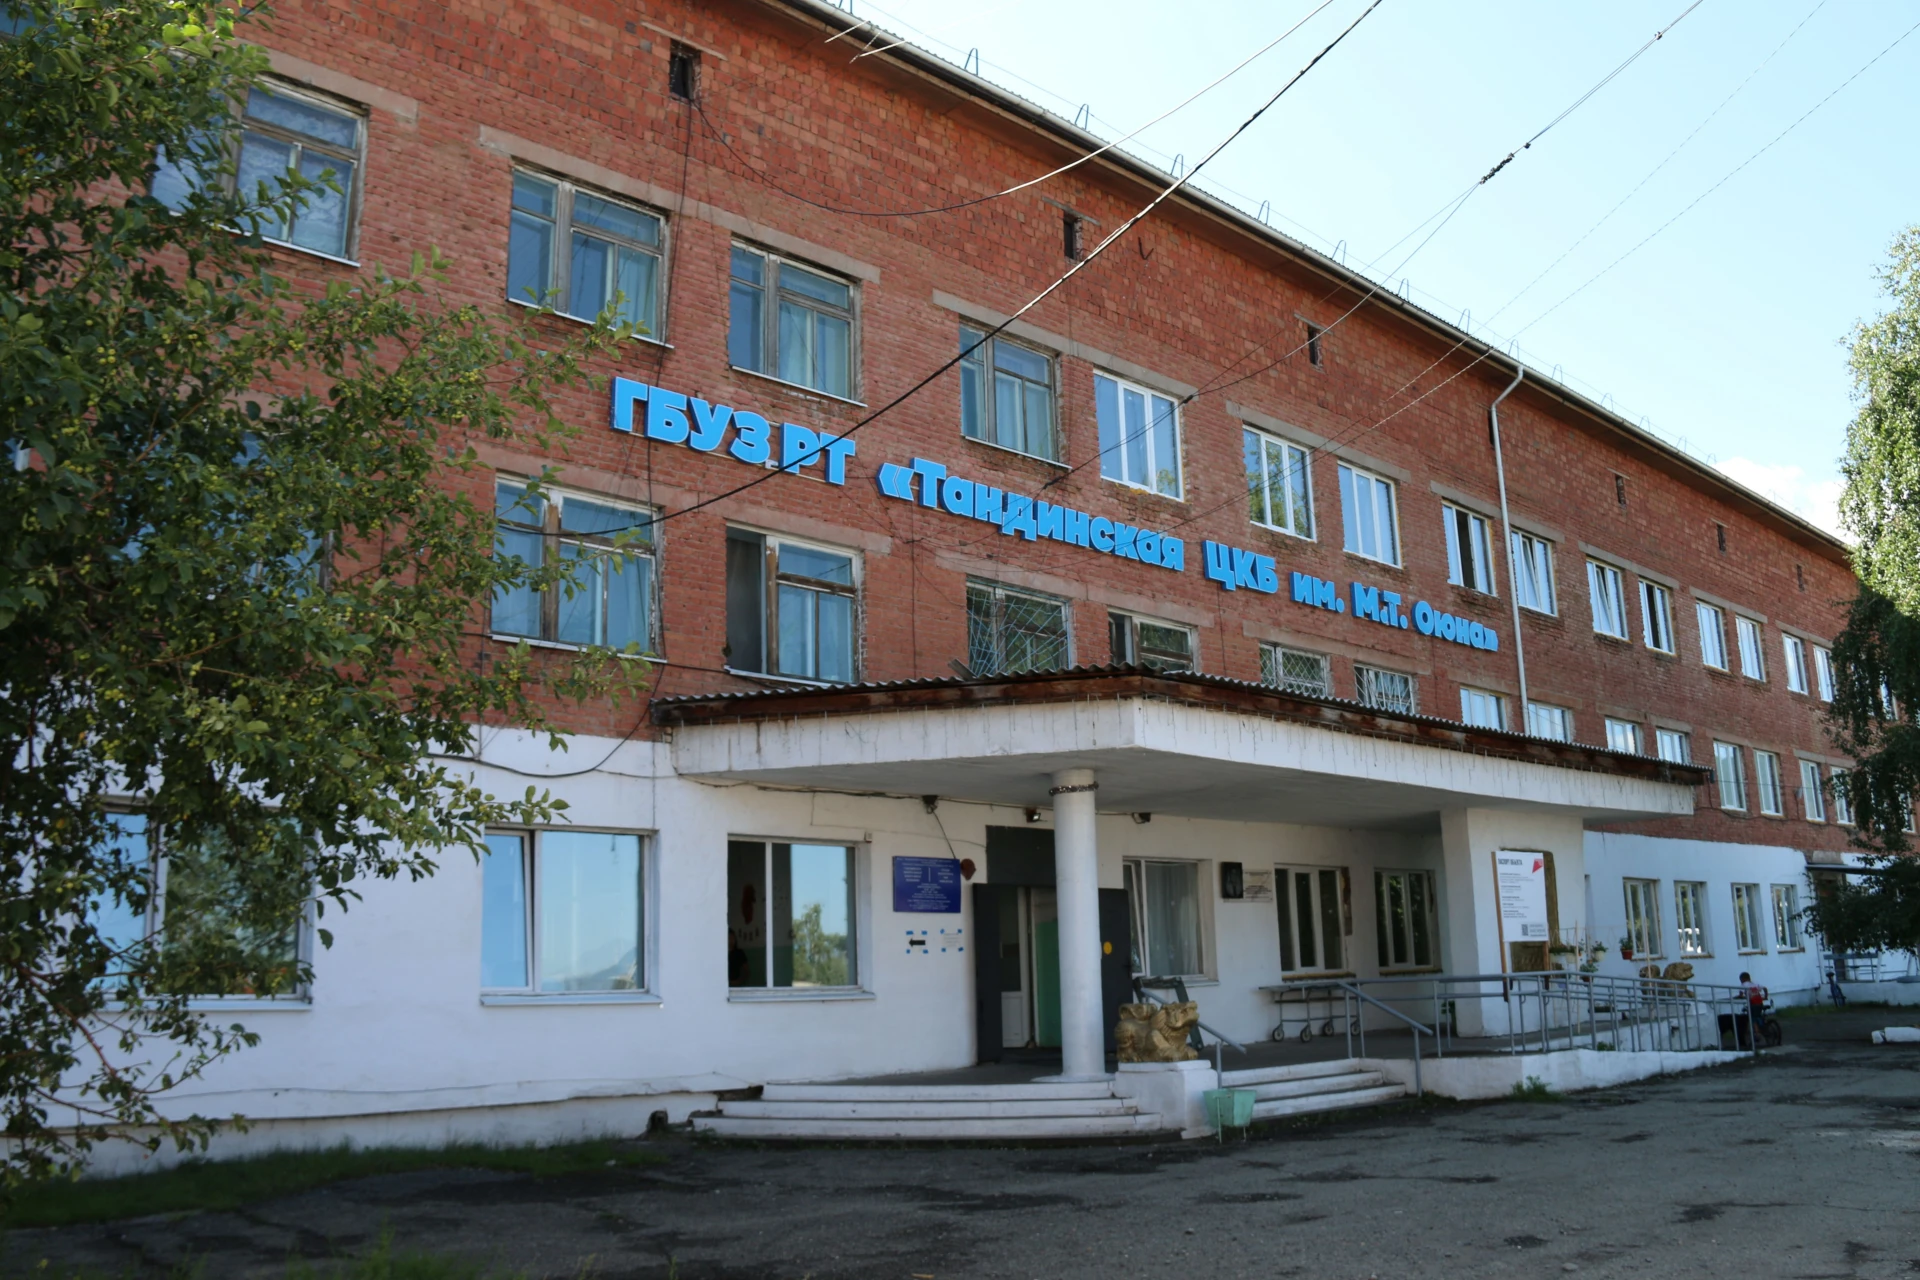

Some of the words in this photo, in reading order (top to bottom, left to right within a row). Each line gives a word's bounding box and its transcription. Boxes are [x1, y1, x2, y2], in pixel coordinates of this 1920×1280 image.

[610, 376, 771, 466] ГБУЗ
[779, 422, 856, 486] РТ
[876, 457, 1184, 571] «Тандинская
[1203, 540, 1279, 593] ЦКБ
[1290, 571, 1345, 613] им.
[1350, 581, 1408, 630] М.Т.
[1411, 601, 1498, 652] Оюна»
